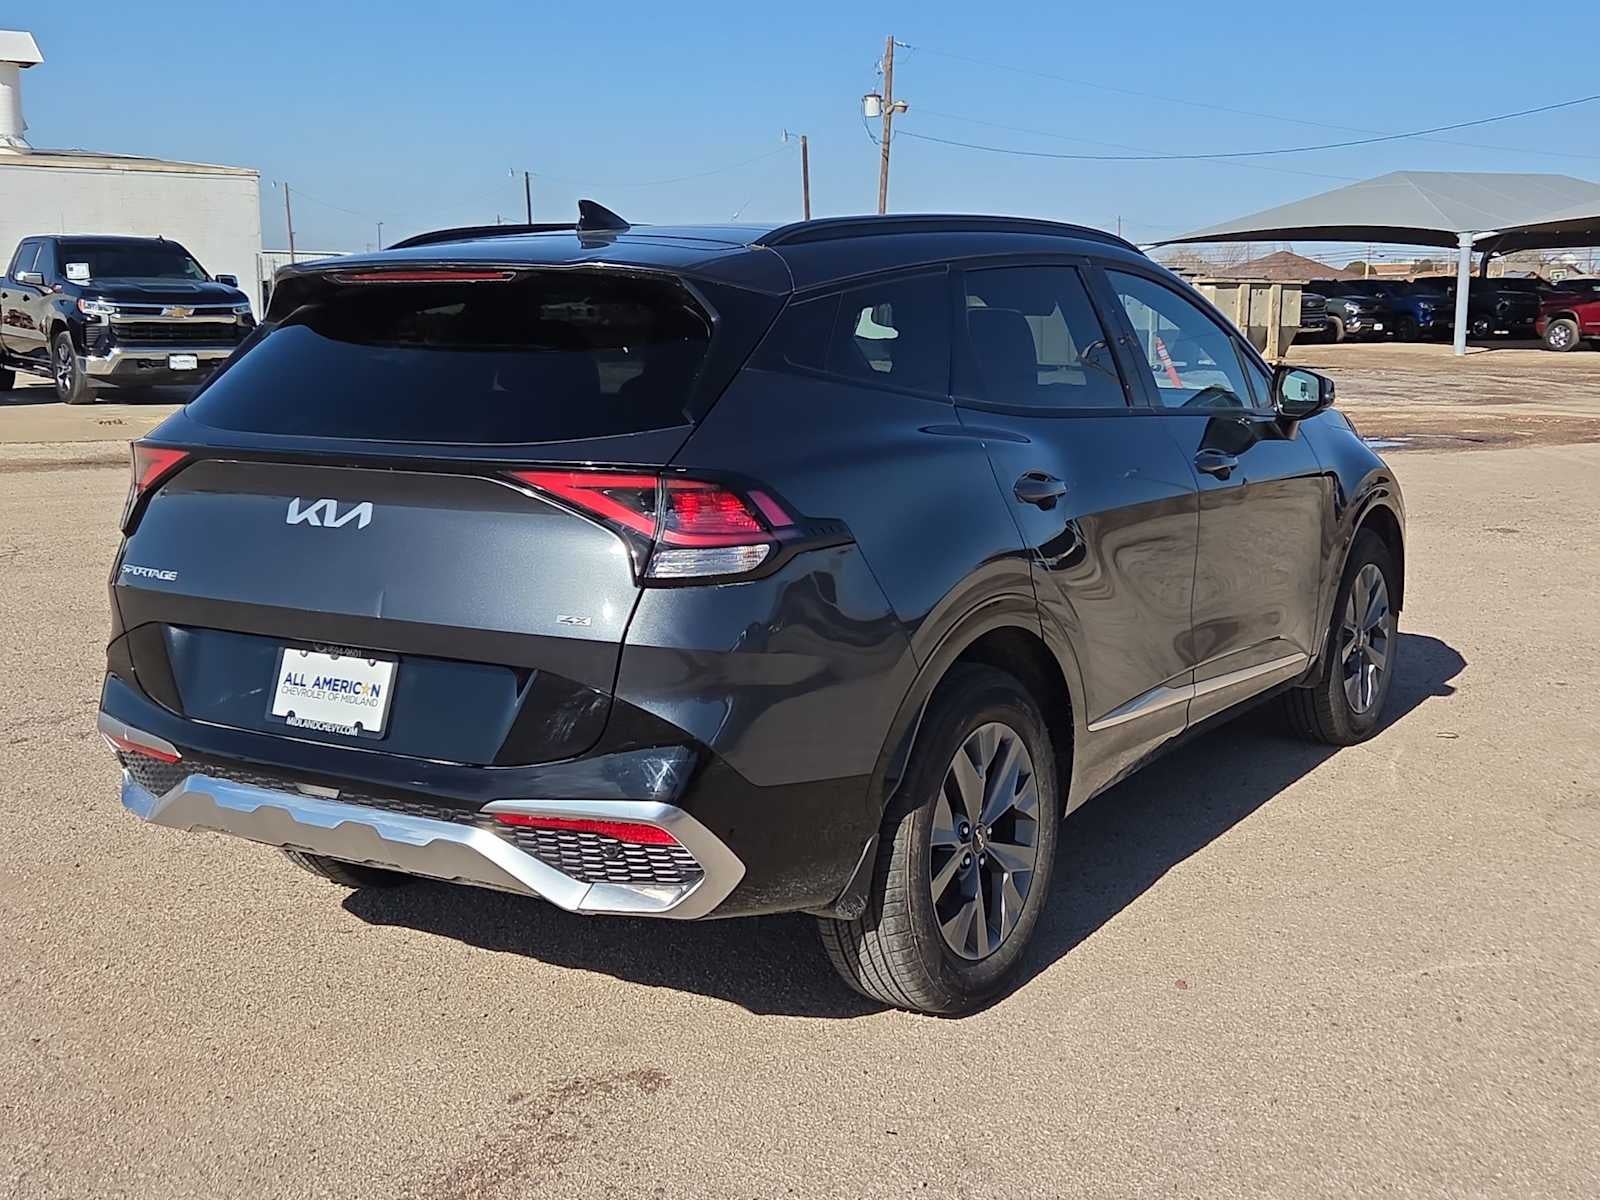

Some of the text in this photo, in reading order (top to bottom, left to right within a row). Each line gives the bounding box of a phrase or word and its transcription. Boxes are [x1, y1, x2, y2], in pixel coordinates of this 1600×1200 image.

[286, 496, 374, 530] KIA
[121, 563, 178, 581] SPORTAGE
[283, 671, 306, 688] ALL
[280, 685, 379, 708] CHEVROLET OF MIDLAND
